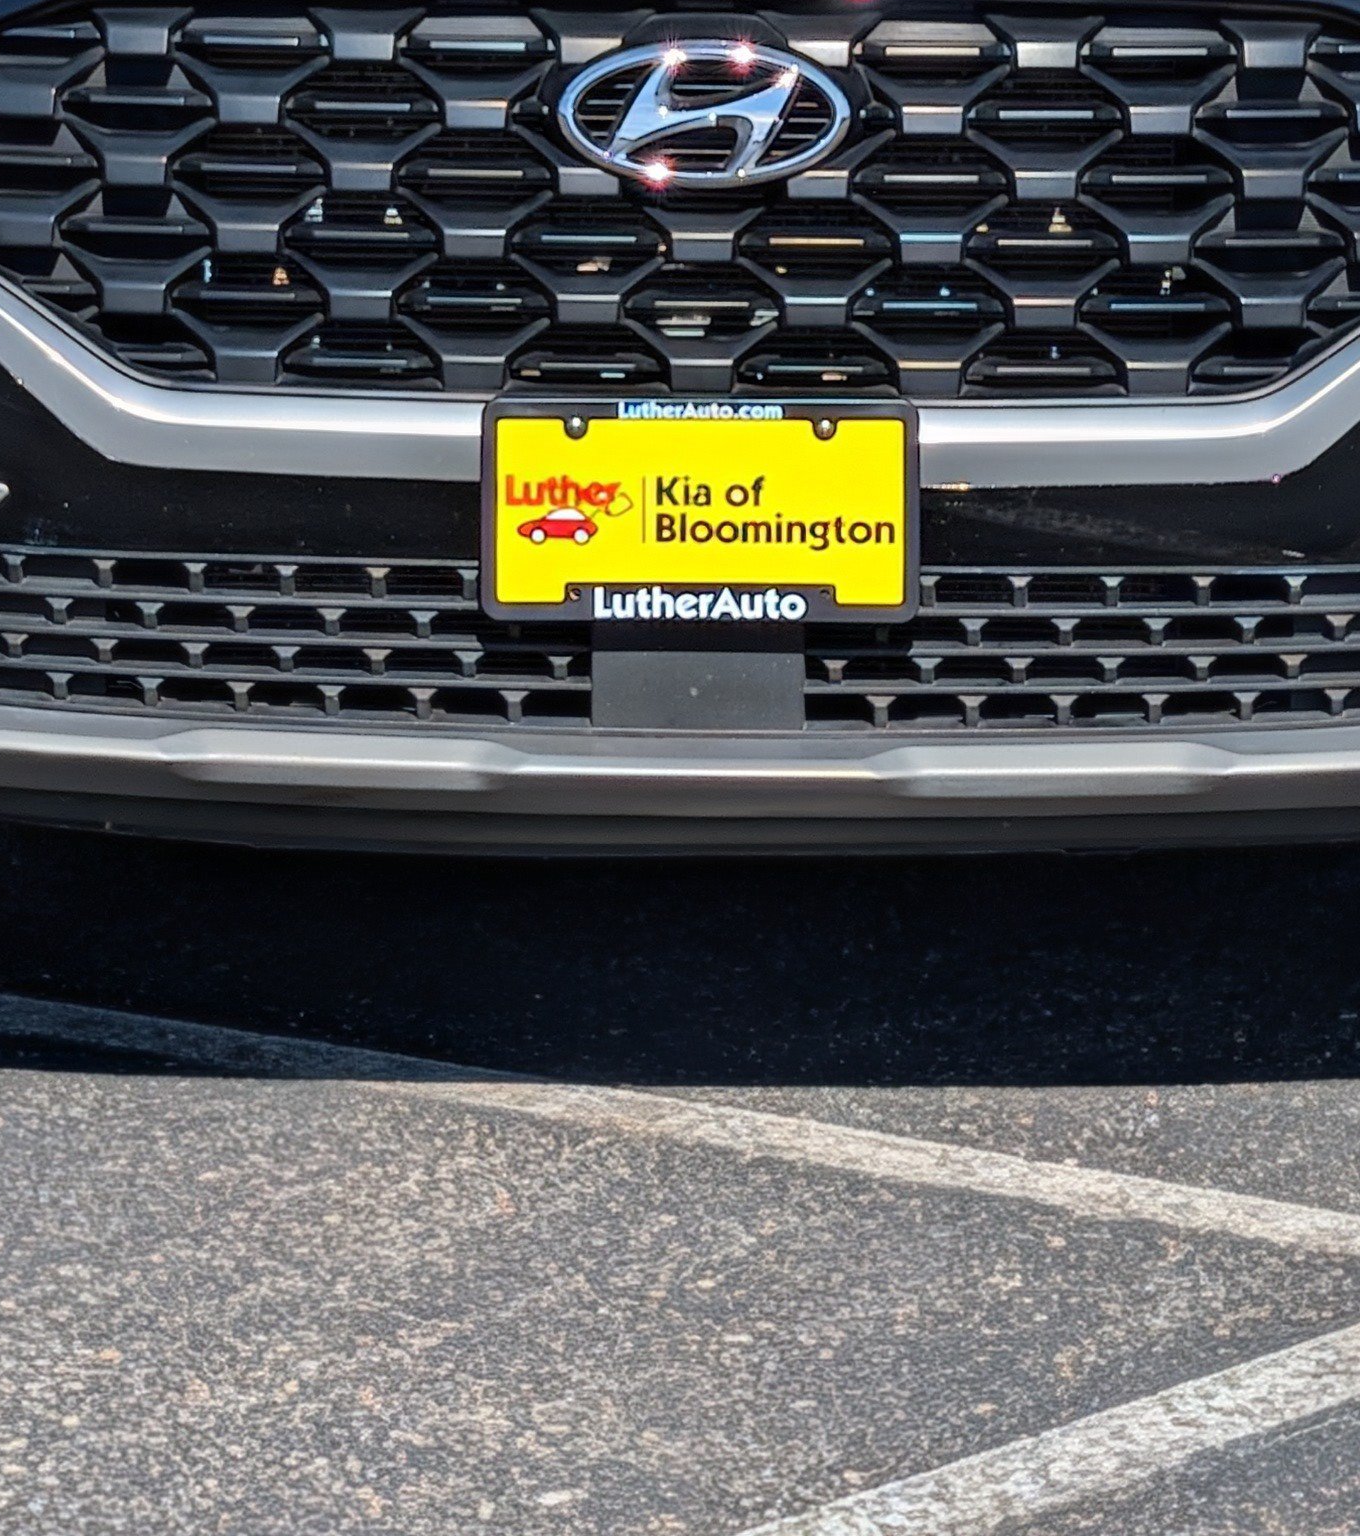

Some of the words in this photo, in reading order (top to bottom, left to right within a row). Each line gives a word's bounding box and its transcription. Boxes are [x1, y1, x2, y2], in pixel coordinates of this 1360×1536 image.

[617, 400, 784, 420] LutherAuto.com
[505, 474, 621, 507] Luther
[656, 476, 712, 507] Kia
[725, 476, 766, 507] of
[656, 512, 896, 552] Bloomington
[592, 585, 808, 621] LutherAuto
